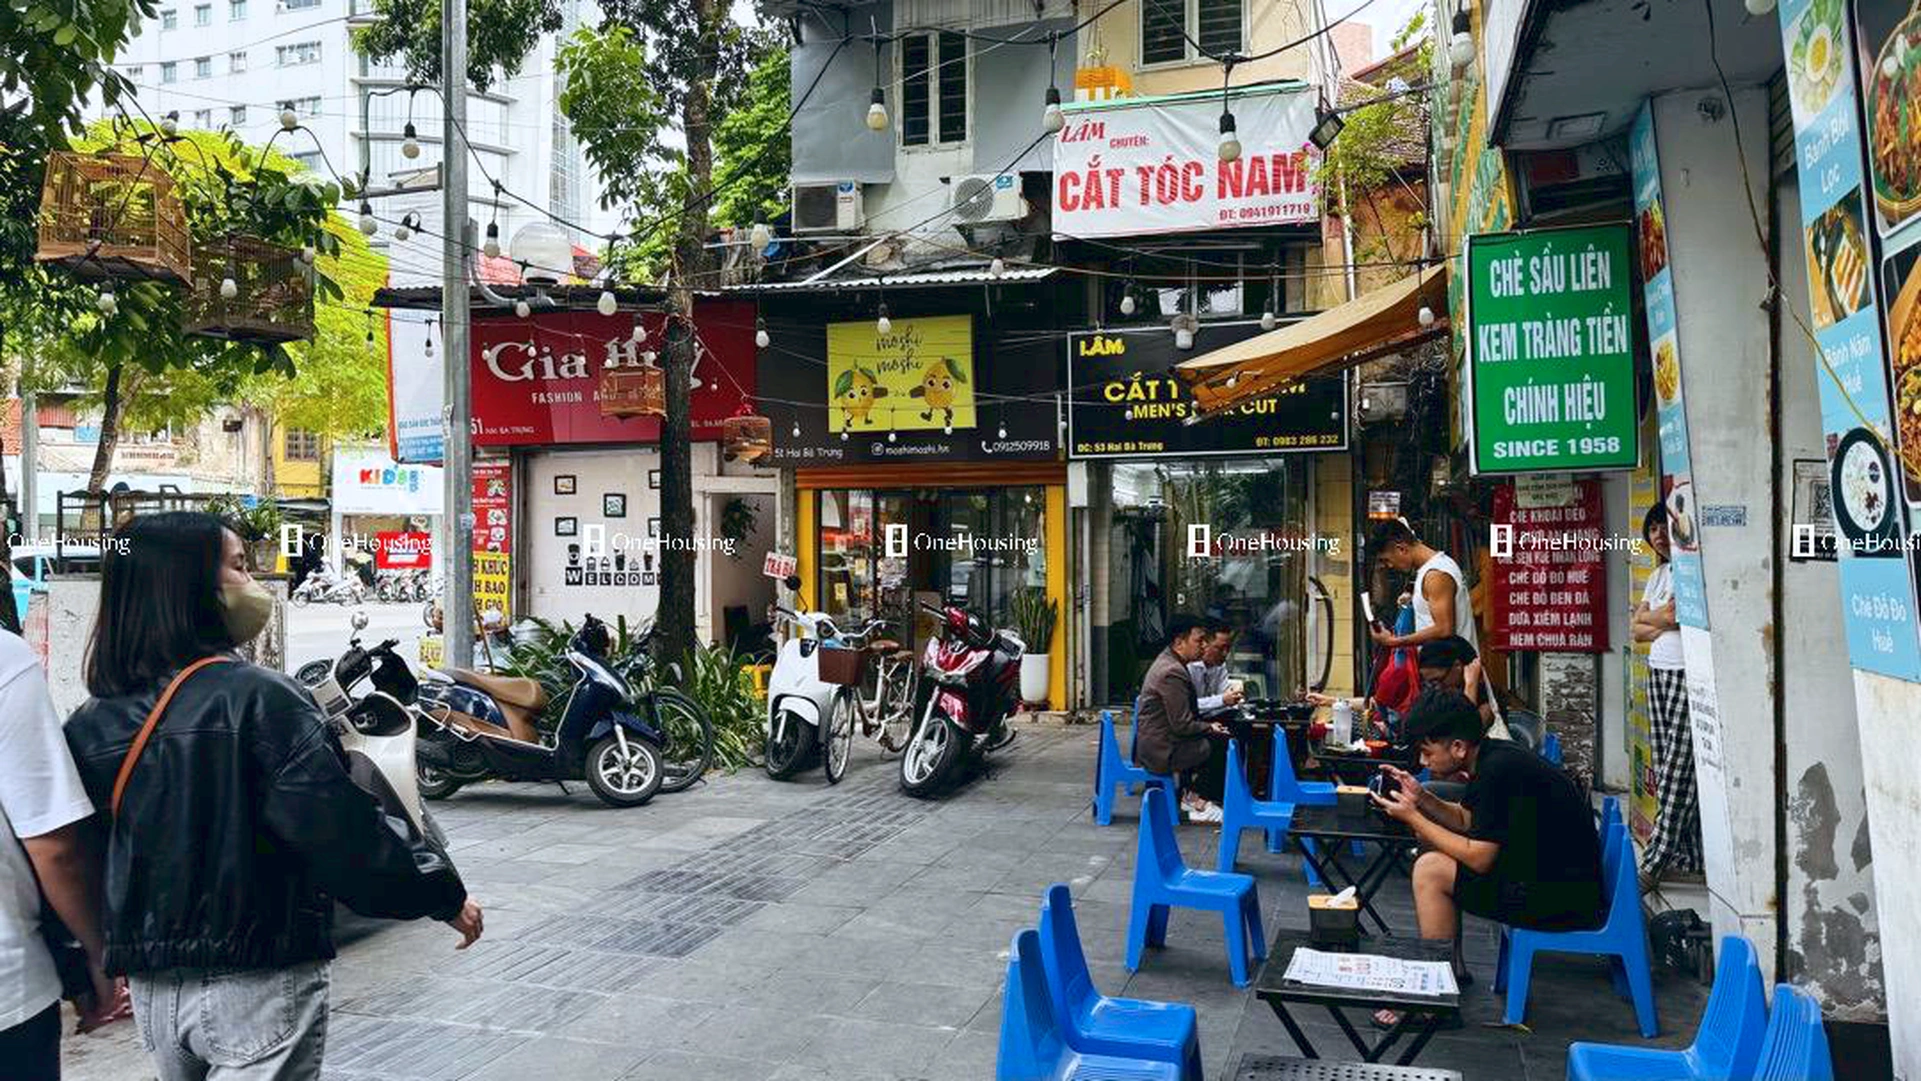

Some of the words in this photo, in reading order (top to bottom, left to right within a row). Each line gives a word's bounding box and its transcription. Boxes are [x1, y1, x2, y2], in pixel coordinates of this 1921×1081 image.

[1061, 119, 1105, 143] LÂM
[1059, 155, 1125, 212] CẮT
[1137, 154, 1204, 206] TÓC
[1217, 152, 1308, 200] NAM
[1490, 250, 1524, 298] CHÈ
[1529, 242, 1565, 295] SẦU
[1570, 244, 1611, 292] LIÊN
[875, 325, 922, 352] moshi
[1479, 322, 1518, 363] KEM
[1522, 312, 1582, 360] TRÀNG
[1586, 302, 1627, 355] TIỀN
[1080, 335, 1125, 357] LÂM
[486, 341, 590, 382] Gia
[876, 349, 923, 375] moshi
[532, 390, 583, 405] FASHION
[1103, 371, 1160, 402] CẮT
[1133, 402, 1186, 419] MEN'S
[1240, 398, 1278, 414] CUT
[1504, 377, 1559, 426] CHÍNH
[1564, 374, 1606, 430] HIỆU
[991, 440, 1051, 453] 0912509918
[1493, 439, 1560, 458] SINCE
[1567, 437, 1621, 455] 1958
[566, 568, 661, 585] WELCOM
[1563, 612, 1592, 628] LẠNH
[1509, 632, 1534, 646] NEM
